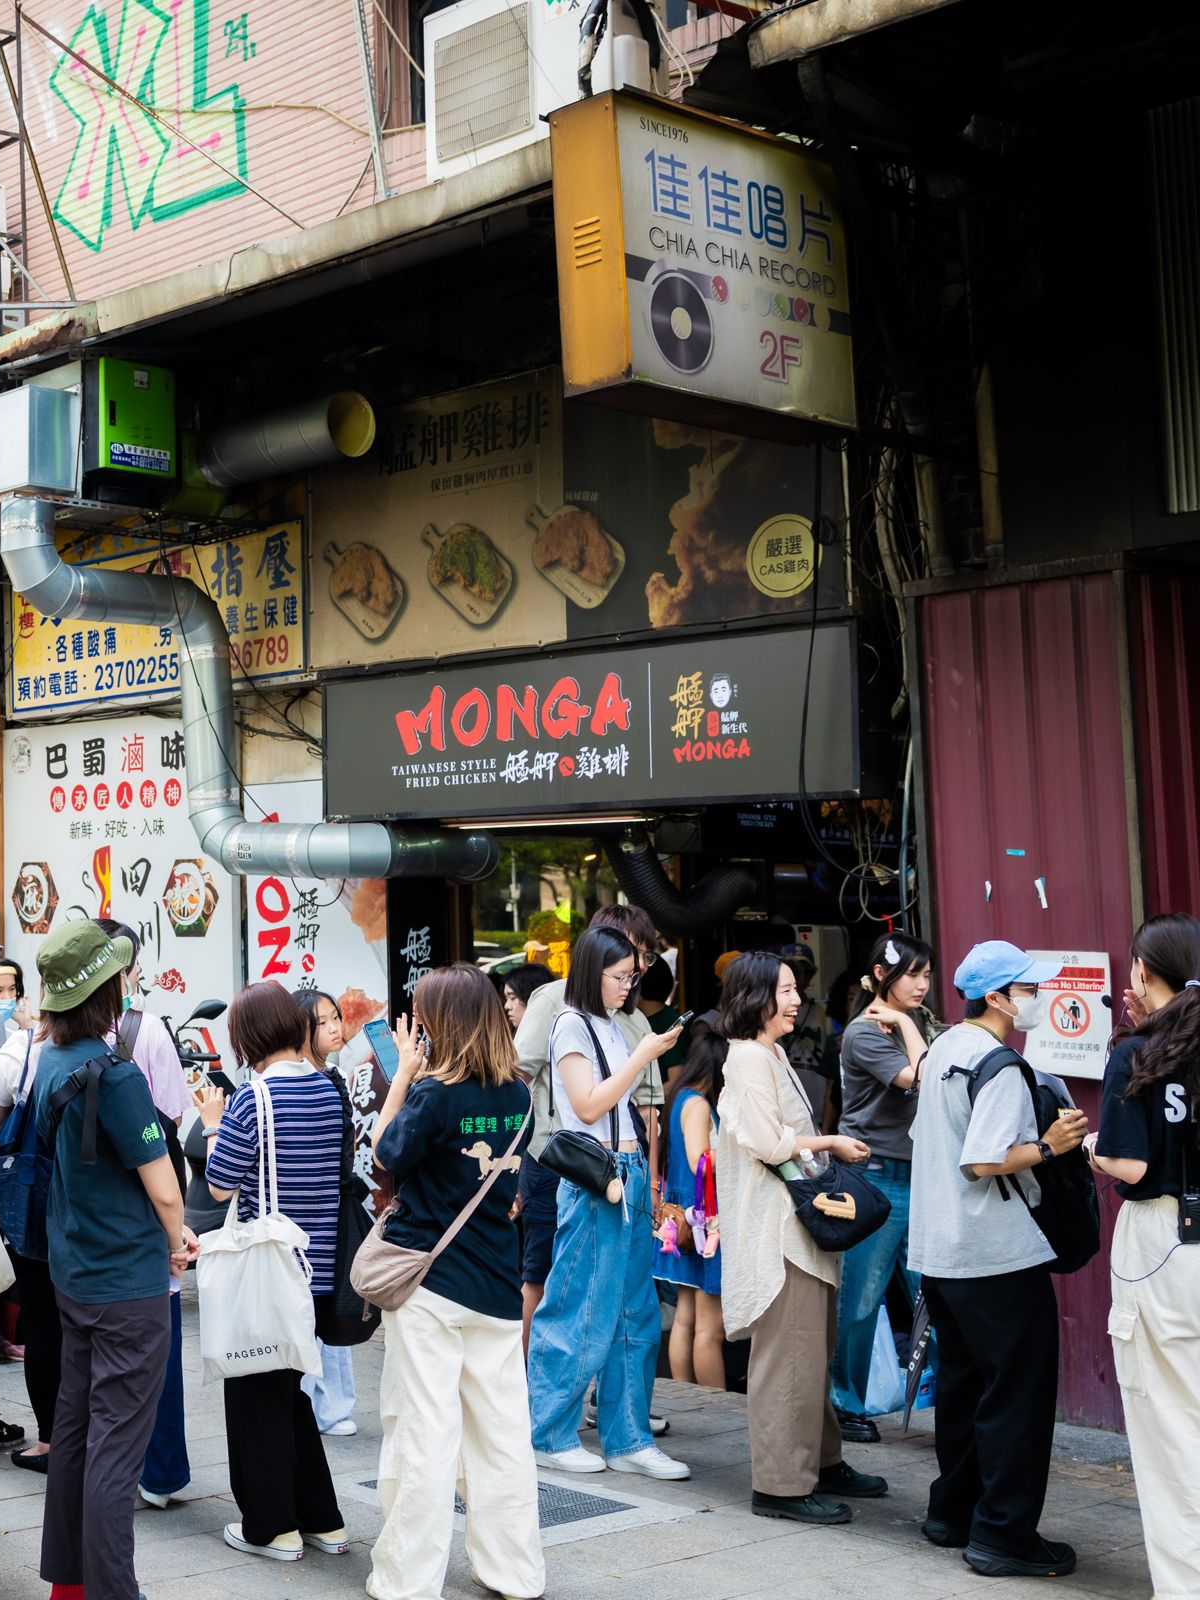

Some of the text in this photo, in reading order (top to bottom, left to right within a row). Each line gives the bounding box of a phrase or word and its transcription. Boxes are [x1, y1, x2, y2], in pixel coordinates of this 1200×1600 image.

[640, 117, 689, 144] SINCE1976
[644, 148, 834, 264] 佳佳唱片
[649, 226, 835, 296] CHIA CHIA RECORD
[759, 330, 800, 380] 2F
[379, 391, 551, 477] 艋舺雞排
[765, 534, 803, 559] 嚴選
[210, 529, 297, 600] 指壓
[760, 558, 809, 576] CAS雞肉
[225, 595, 298, 636] 養生保健
[94, 652, 179, 691] 23702255
[395, 672, 633, 756] MONGA
[669, 671, 705, 740] 艋舺
[721, 722, 748, 735] 新生代
[46, 731, 186, 779] 巴蜀滷味
[673, 738, 751, 763] MONGA
[392, 758, 497, 776] TAIWANESE STYLE
[406, 771, 497, 788] FRIED CHICKEN
[51, 783, 180, 811] 傳承匠人精神
[1062, 955, 1079, 965] 公告
[1060, 981, 1072, 990] No
[1073, 982, 1105, 992] Littering
[460, 1116, 498, 1134] 侯整理
[226, 1344, 279, 1361] PAGEBOY
